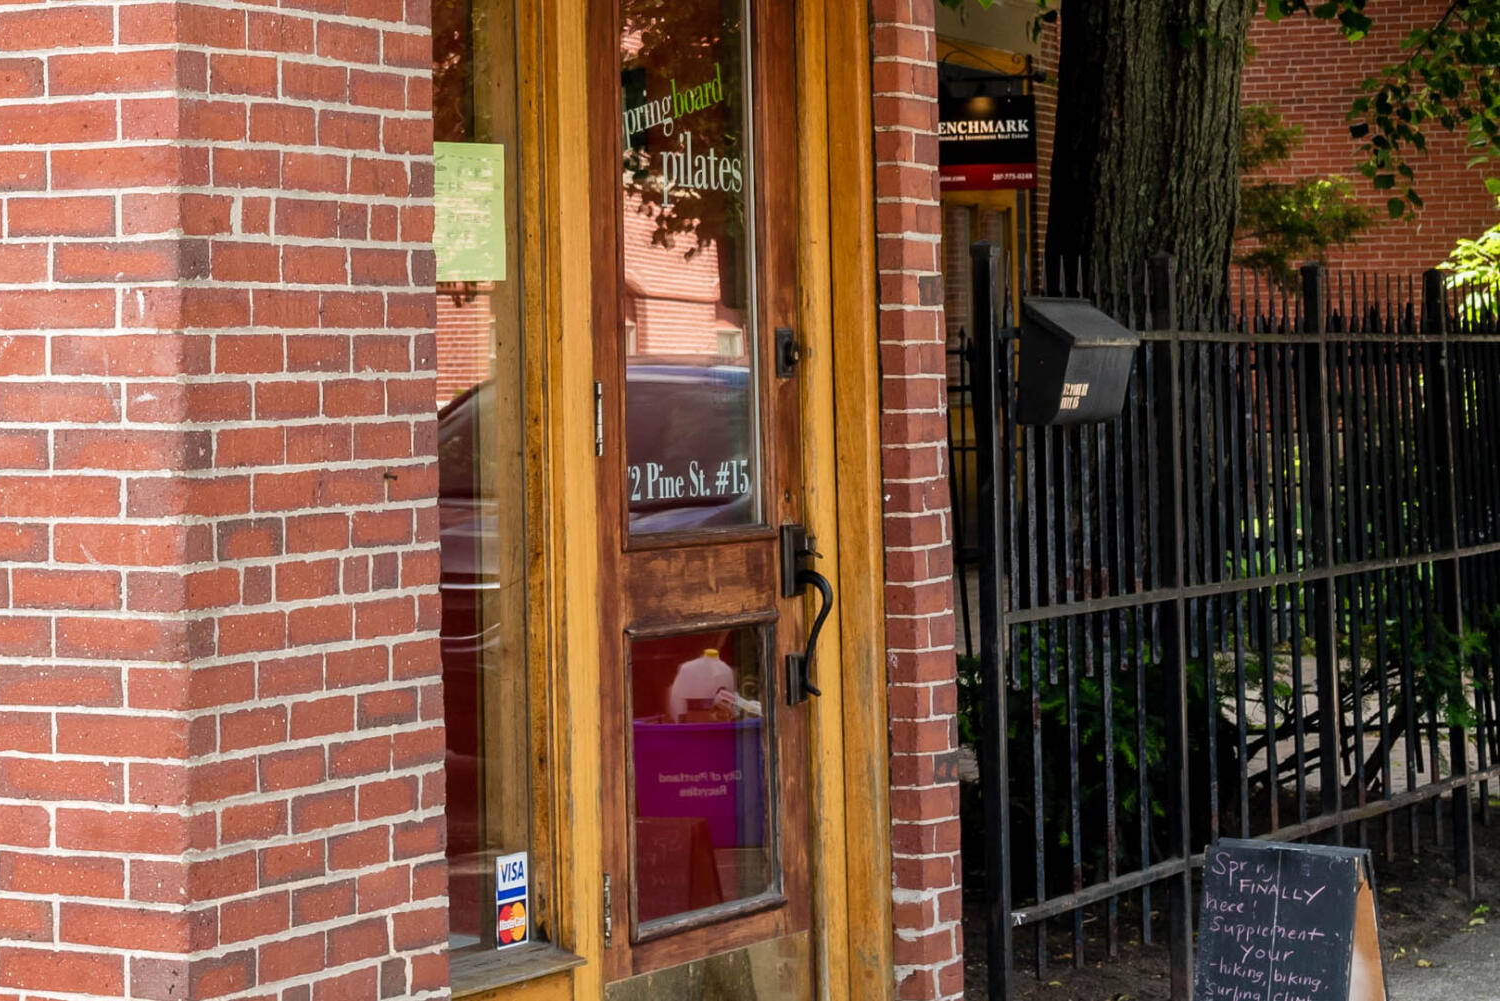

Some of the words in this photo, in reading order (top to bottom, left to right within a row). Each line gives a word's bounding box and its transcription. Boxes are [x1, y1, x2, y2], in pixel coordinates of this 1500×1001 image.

[622, 61, 724, 150] pringboard
[938, 119, 1029, 134] ENCHMARK
[660, 131, 743, 207] pilates
[647, 462, 685, 499] Pine
[689, 460, 711, 498] St.
[715, 458, 750, 495] #15
[500, 860, 525, 884] VISA
